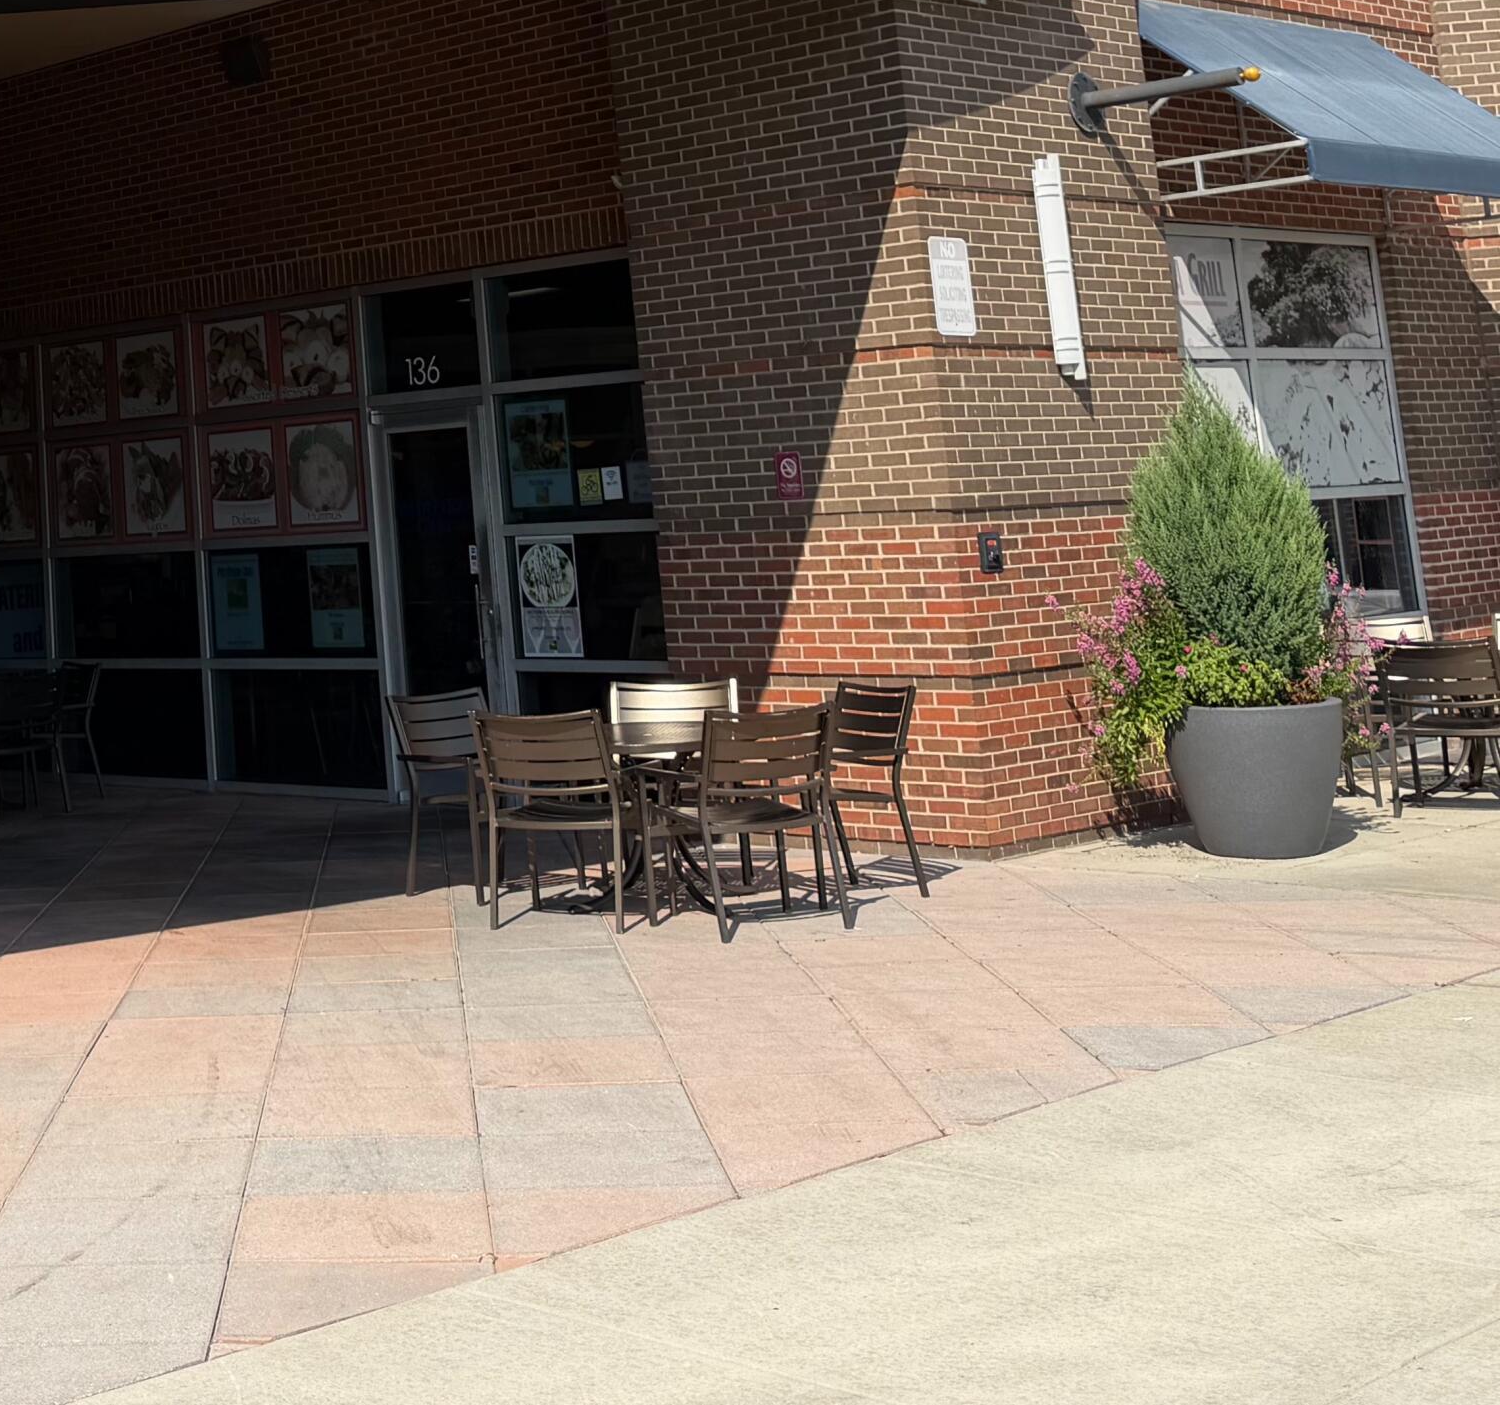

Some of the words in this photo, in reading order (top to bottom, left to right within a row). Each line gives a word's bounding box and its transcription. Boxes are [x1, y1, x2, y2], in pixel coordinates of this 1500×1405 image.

[940, 241, 956, 258] NO
[1187, 253, 1227, 297] GRILL
[405, 356, 441, 385] 136
[12, 624, 44, 653] and
